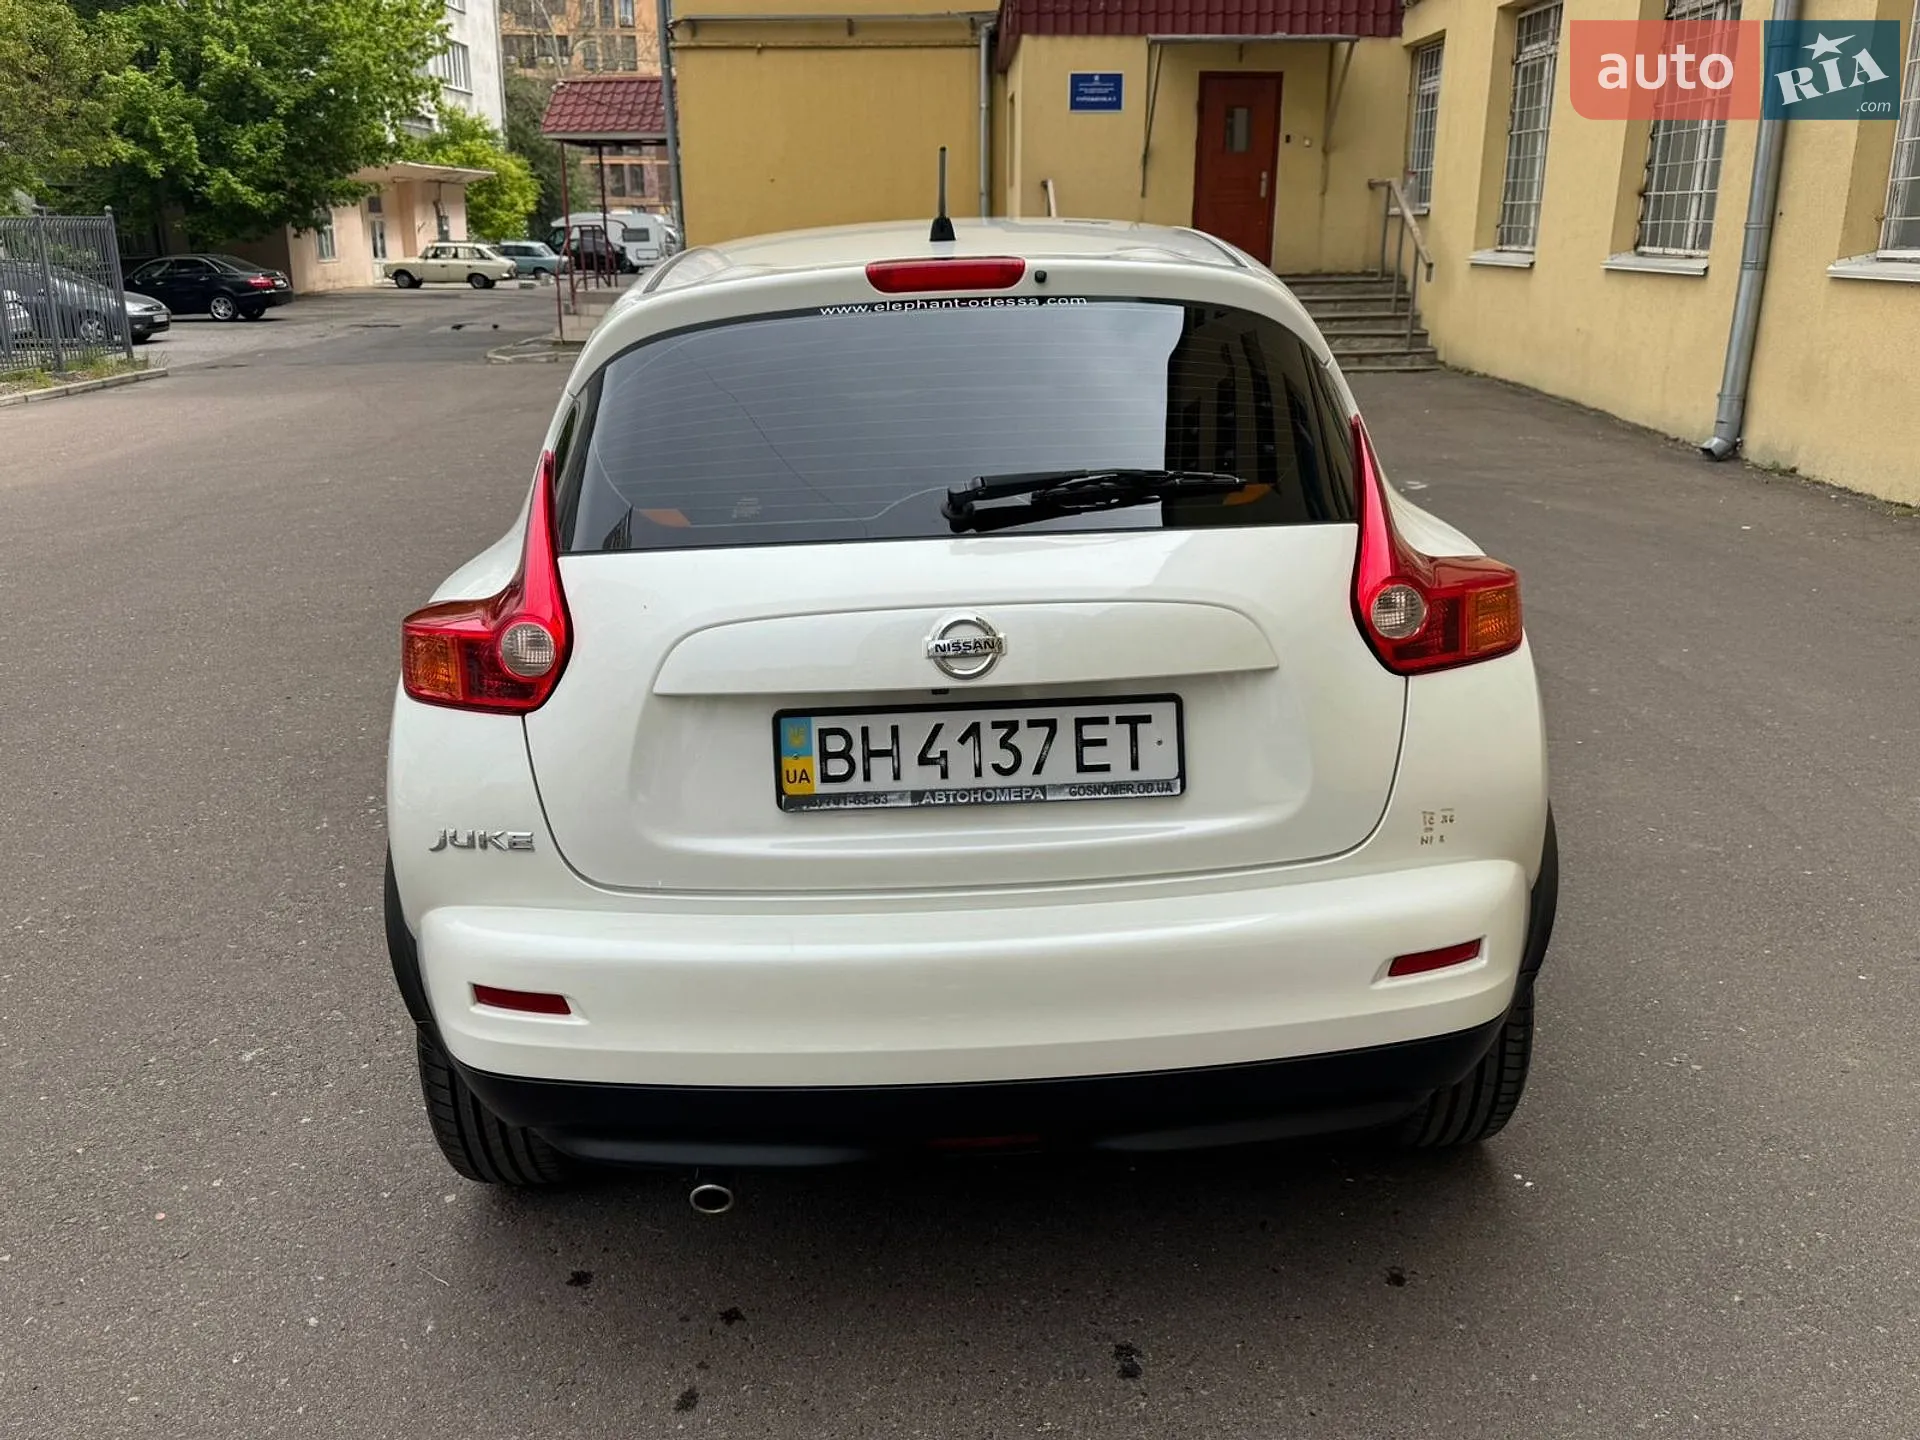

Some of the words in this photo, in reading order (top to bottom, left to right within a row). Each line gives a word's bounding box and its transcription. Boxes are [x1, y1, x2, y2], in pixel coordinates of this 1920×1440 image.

[820, 297, 1087, 315] www.elephant-odessa.com
[934, 640, 995, 653] NISSAN
[818, 724, 900, 784] BH
[917, 718, 1057, 780] 4137
[1074, 714, 1152, 774] ET
[785, 768, 811, 784] UA
[921, 787, 1044, 805] АВТОНОМЕРА
[1069, 781, 1173, 798] GOSNOMER.OD.UA
[429, 828, 535, 852] JUKE
